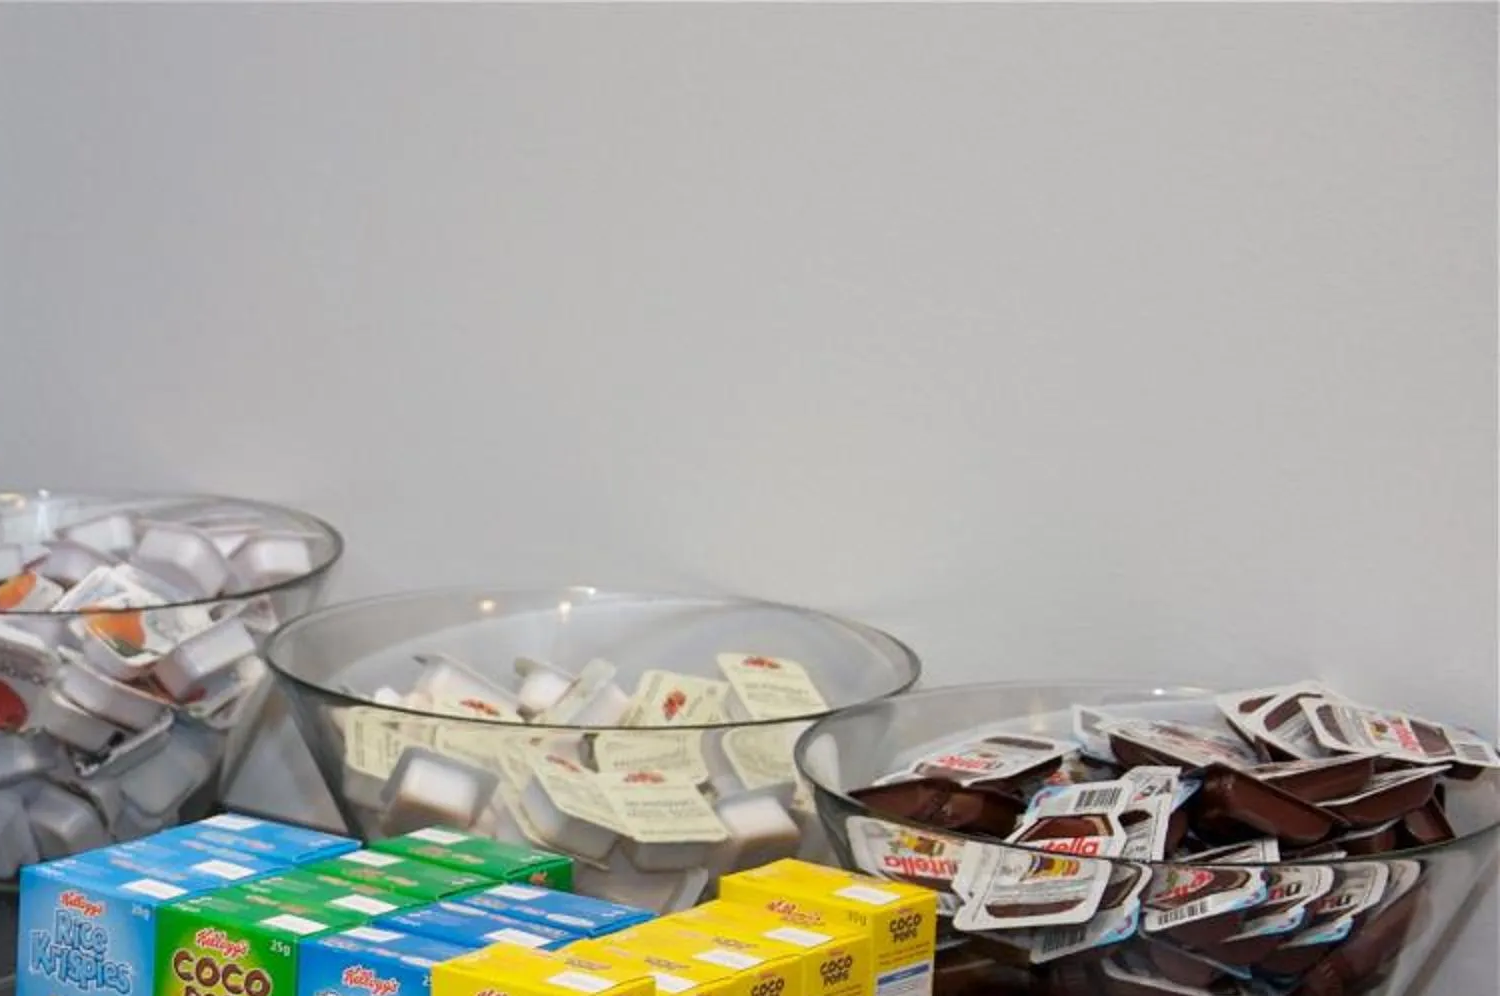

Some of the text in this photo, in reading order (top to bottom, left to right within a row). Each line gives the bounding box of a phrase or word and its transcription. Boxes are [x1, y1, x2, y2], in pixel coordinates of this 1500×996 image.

[55, 910, 108, 955] Rice
[889, 913, 923, 935] COCO
[29, 930, 134, 995] Krispies
[820, 954, 853, 977] COCO
